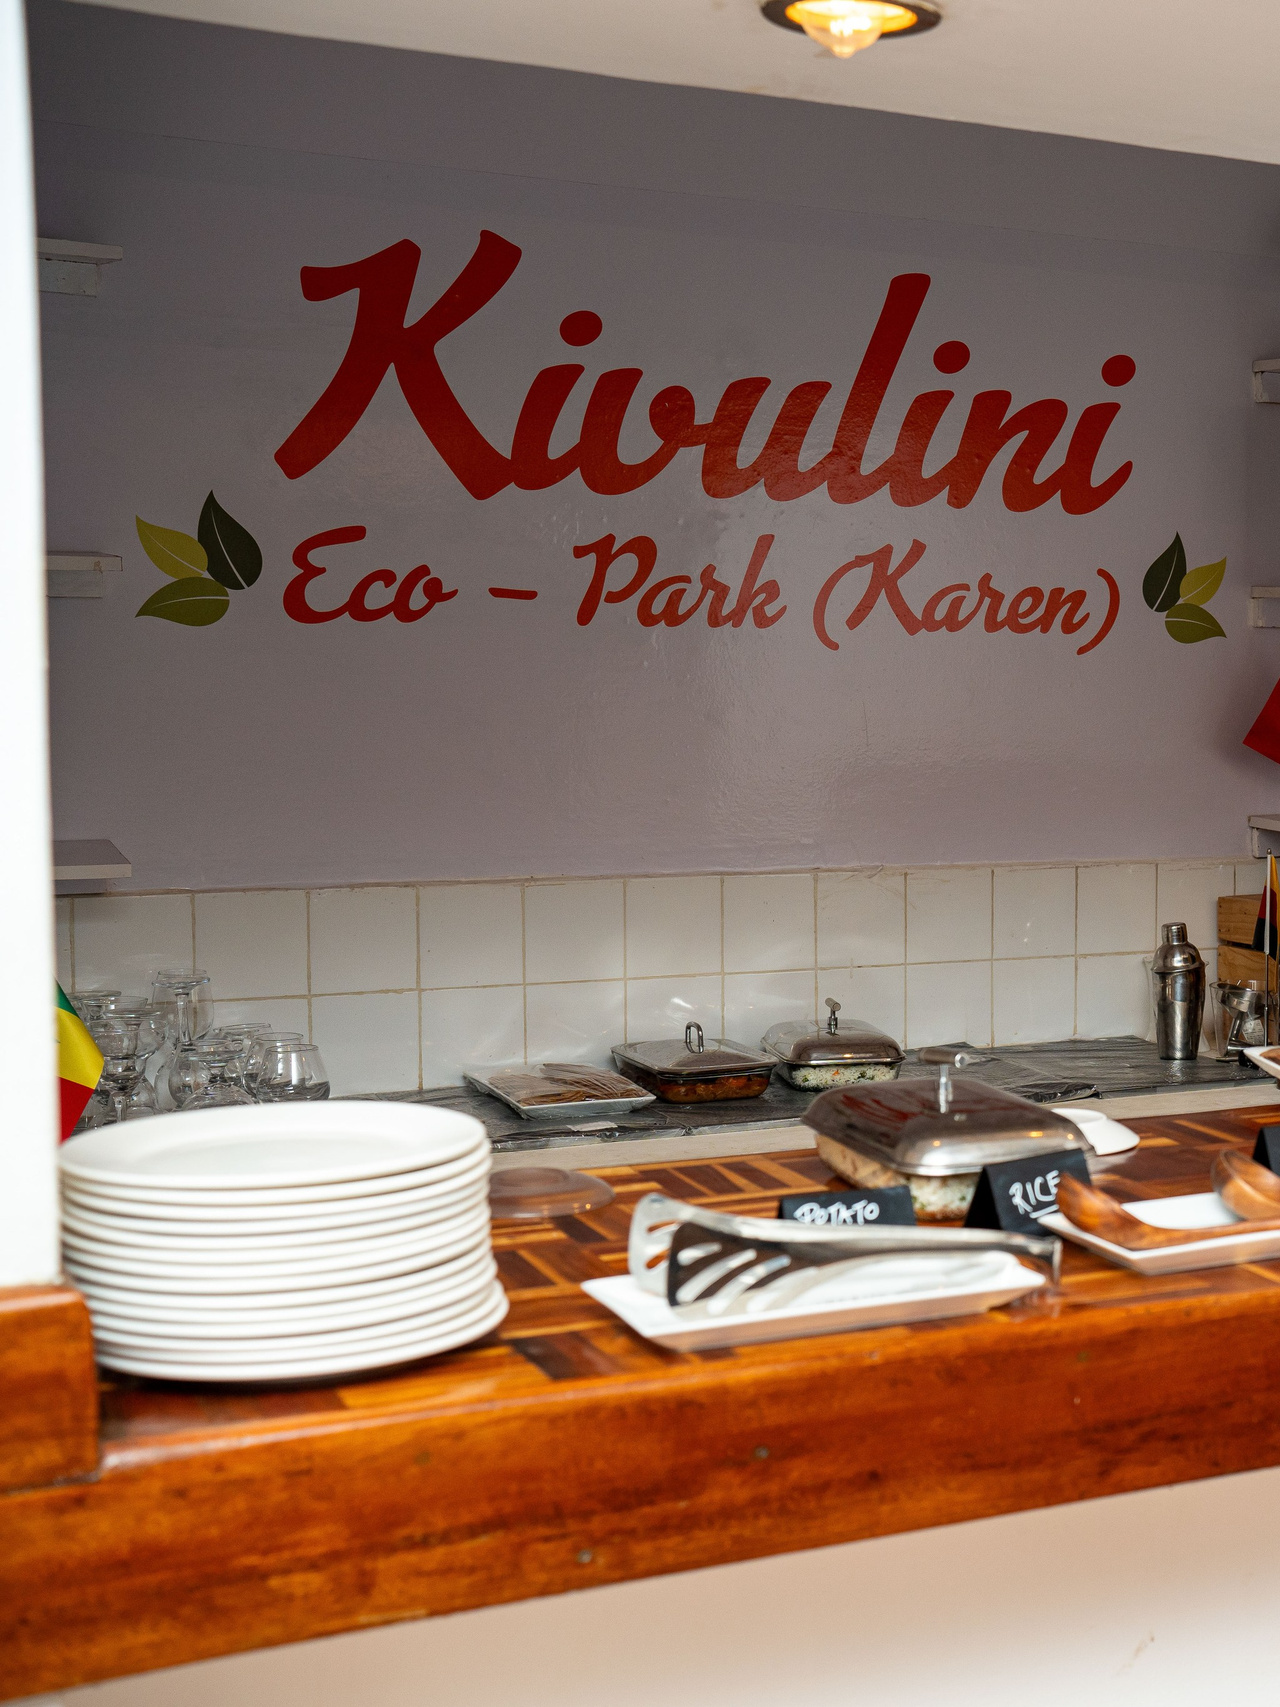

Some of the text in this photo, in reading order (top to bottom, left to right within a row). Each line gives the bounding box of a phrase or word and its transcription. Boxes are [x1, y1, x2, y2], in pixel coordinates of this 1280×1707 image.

[274, 230, 1137, 516] Kivulini
[282, 525, 458, 625] Eco
[572, 533, 788, 630] Park
[812, 539, 1122, 657] (Karen)
[792, 1198, 880, 1226] POTATO
[1008, 1169, 1061, 1215] RICE
